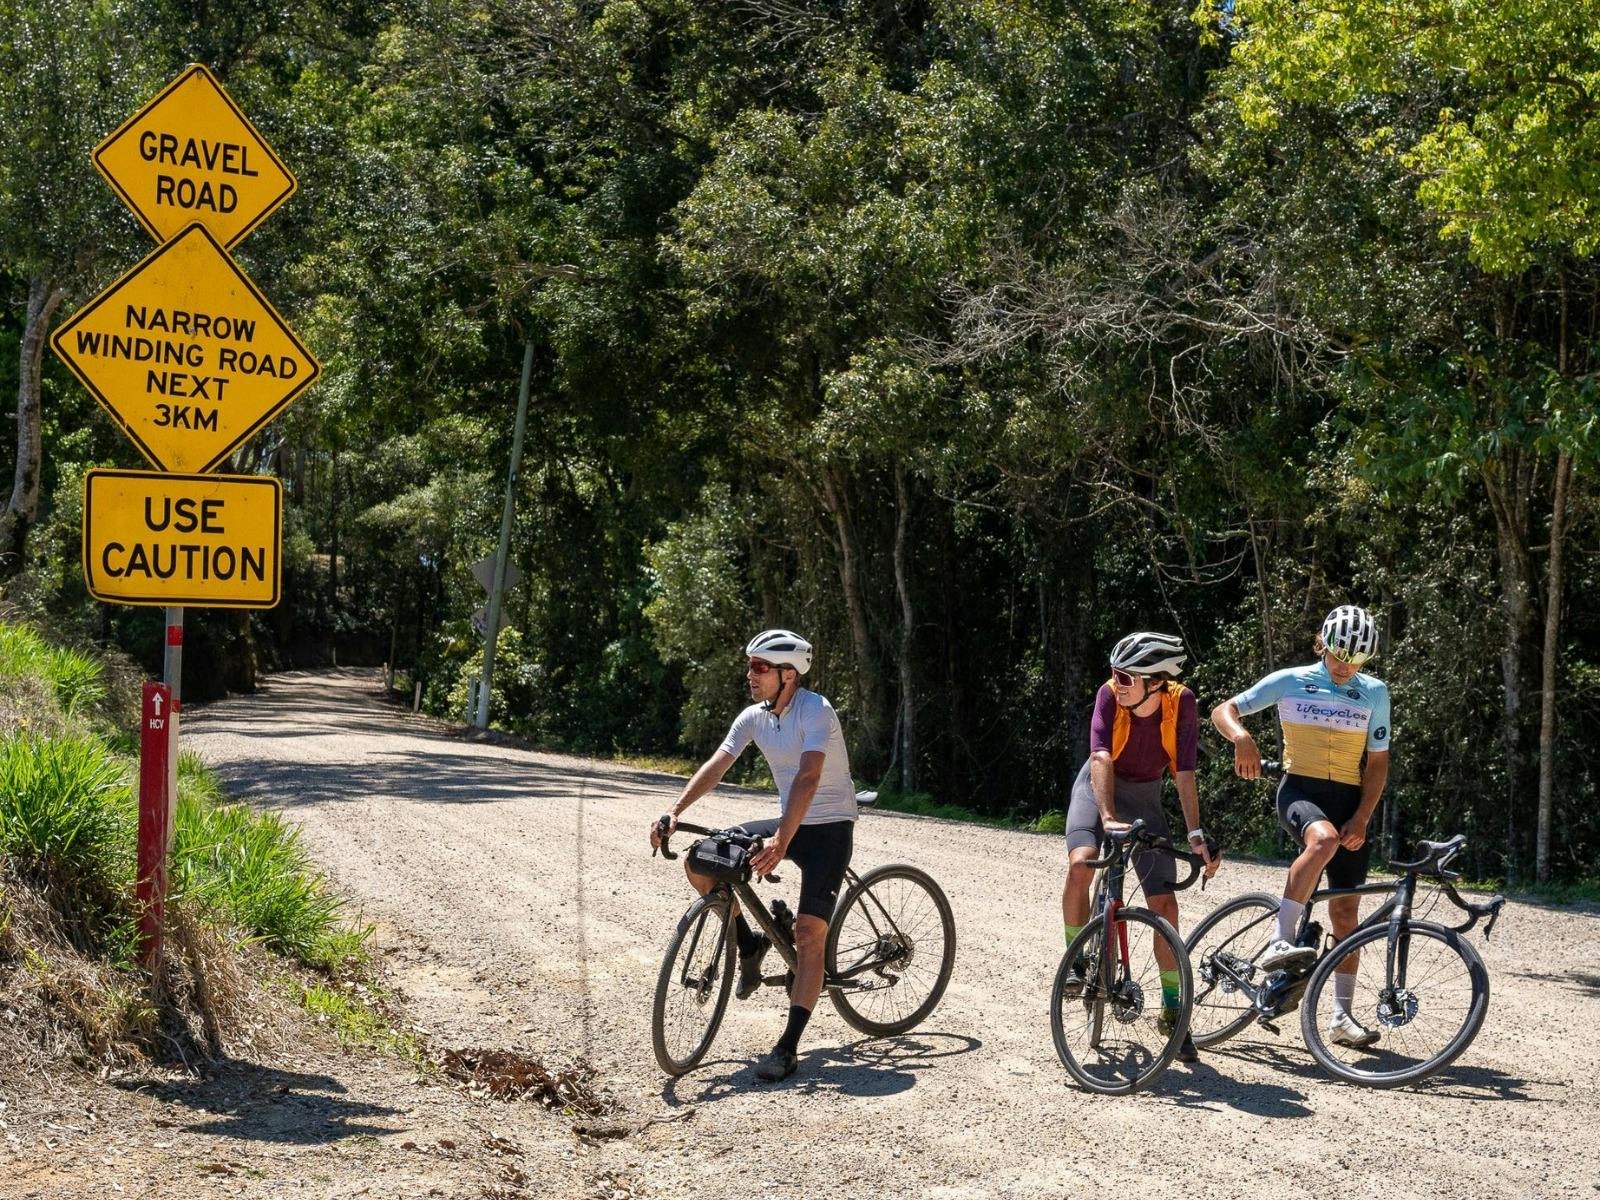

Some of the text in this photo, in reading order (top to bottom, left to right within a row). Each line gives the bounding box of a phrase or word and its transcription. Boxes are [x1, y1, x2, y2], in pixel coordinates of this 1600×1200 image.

[139, 130, 259, 177] GRAVEL
[156, 174, 238, 214] ROAD
[125, 304, 256, 343] NARROW
[76, 330, 298, 380] WINDING ROAD
[146, 369, 230, 401] NEXT
[153, 403, 219, 432] 3KM
[144, 496, 225, 534] USE
[101, 541, 265, 582] CAUTION
[149, 718, 164, 729] HCV
[1296, 703, 1367, 721] lifecycles
[1303, 714, 1360, 728] TRAVEL
